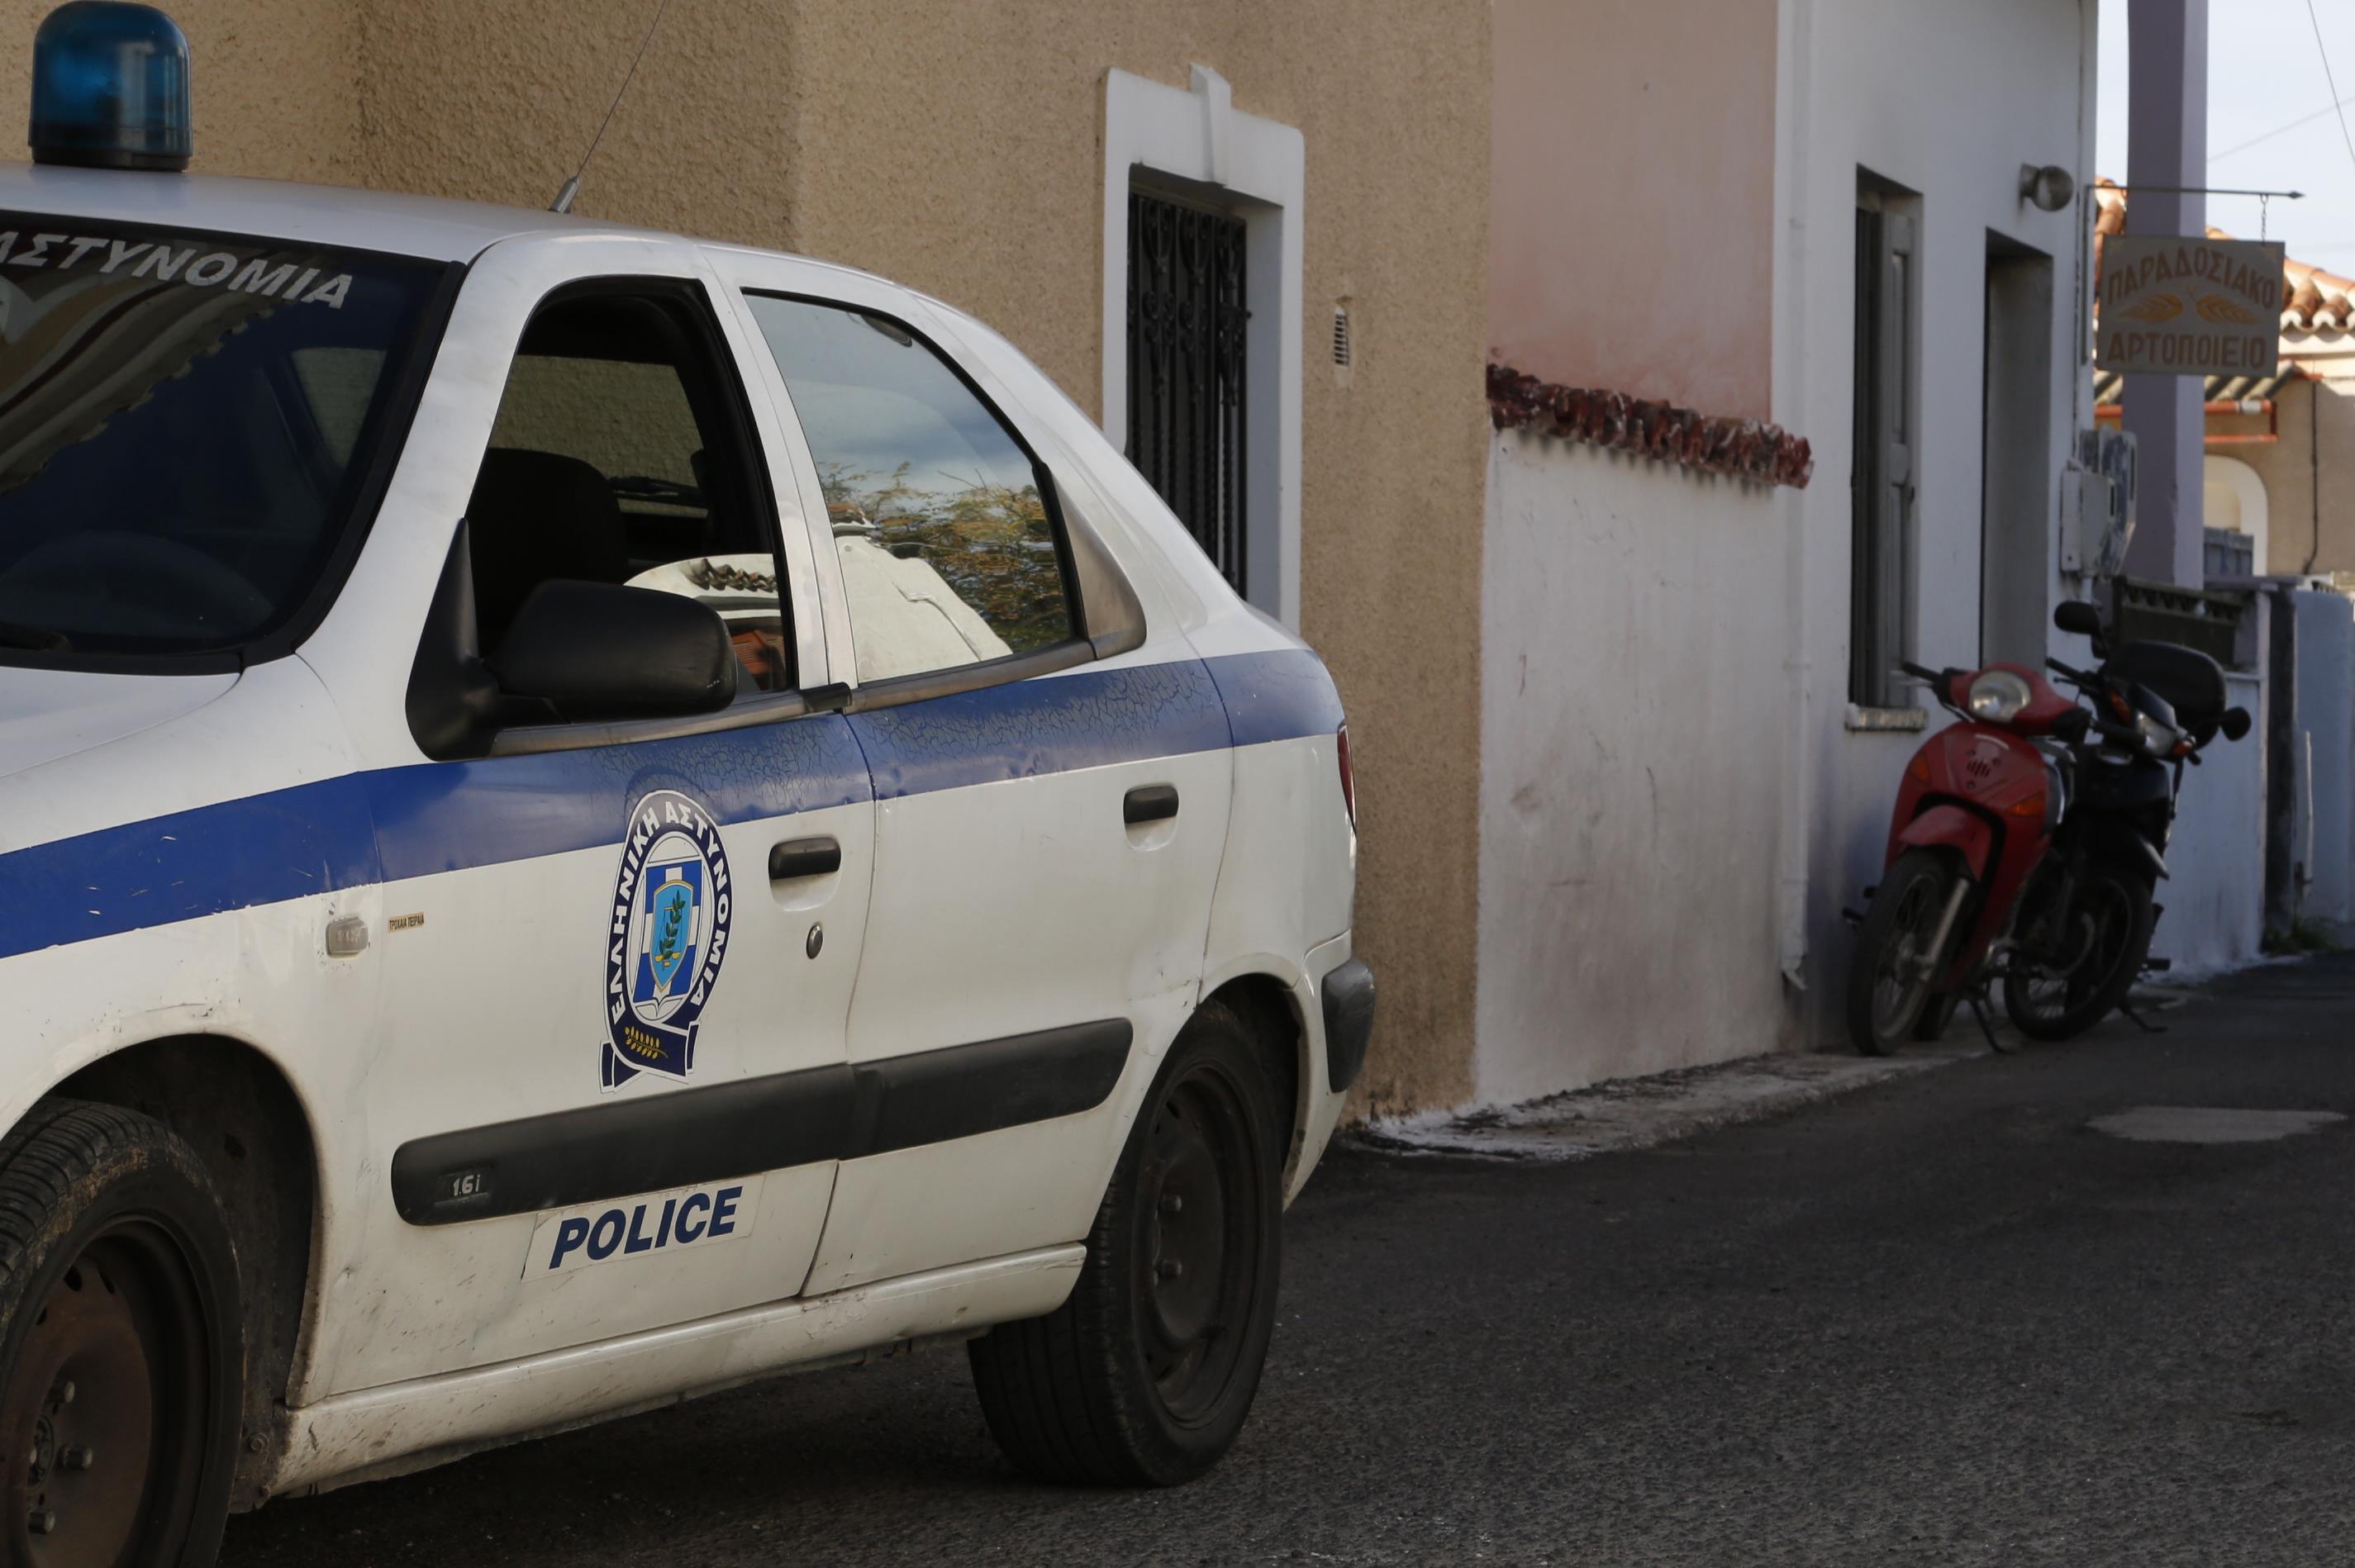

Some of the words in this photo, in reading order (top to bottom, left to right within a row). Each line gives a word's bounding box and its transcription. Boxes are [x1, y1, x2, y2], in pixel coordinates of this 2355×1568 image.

[2106, 245, 2276, 310] ΠΑΡΑΔΟΣΙΑΚΟ
[2106, 330, 2267, 369] ΑΡΤΟΠΟΙΕΙΟ
[610, 806, 660, 1025] ΕΛΛΗΝΙΚΗ
[665, 801, 730, 1006] ΑΣΤΥΝΟΜΙΑ
[549, 1186, 743, 1270] POLICE
